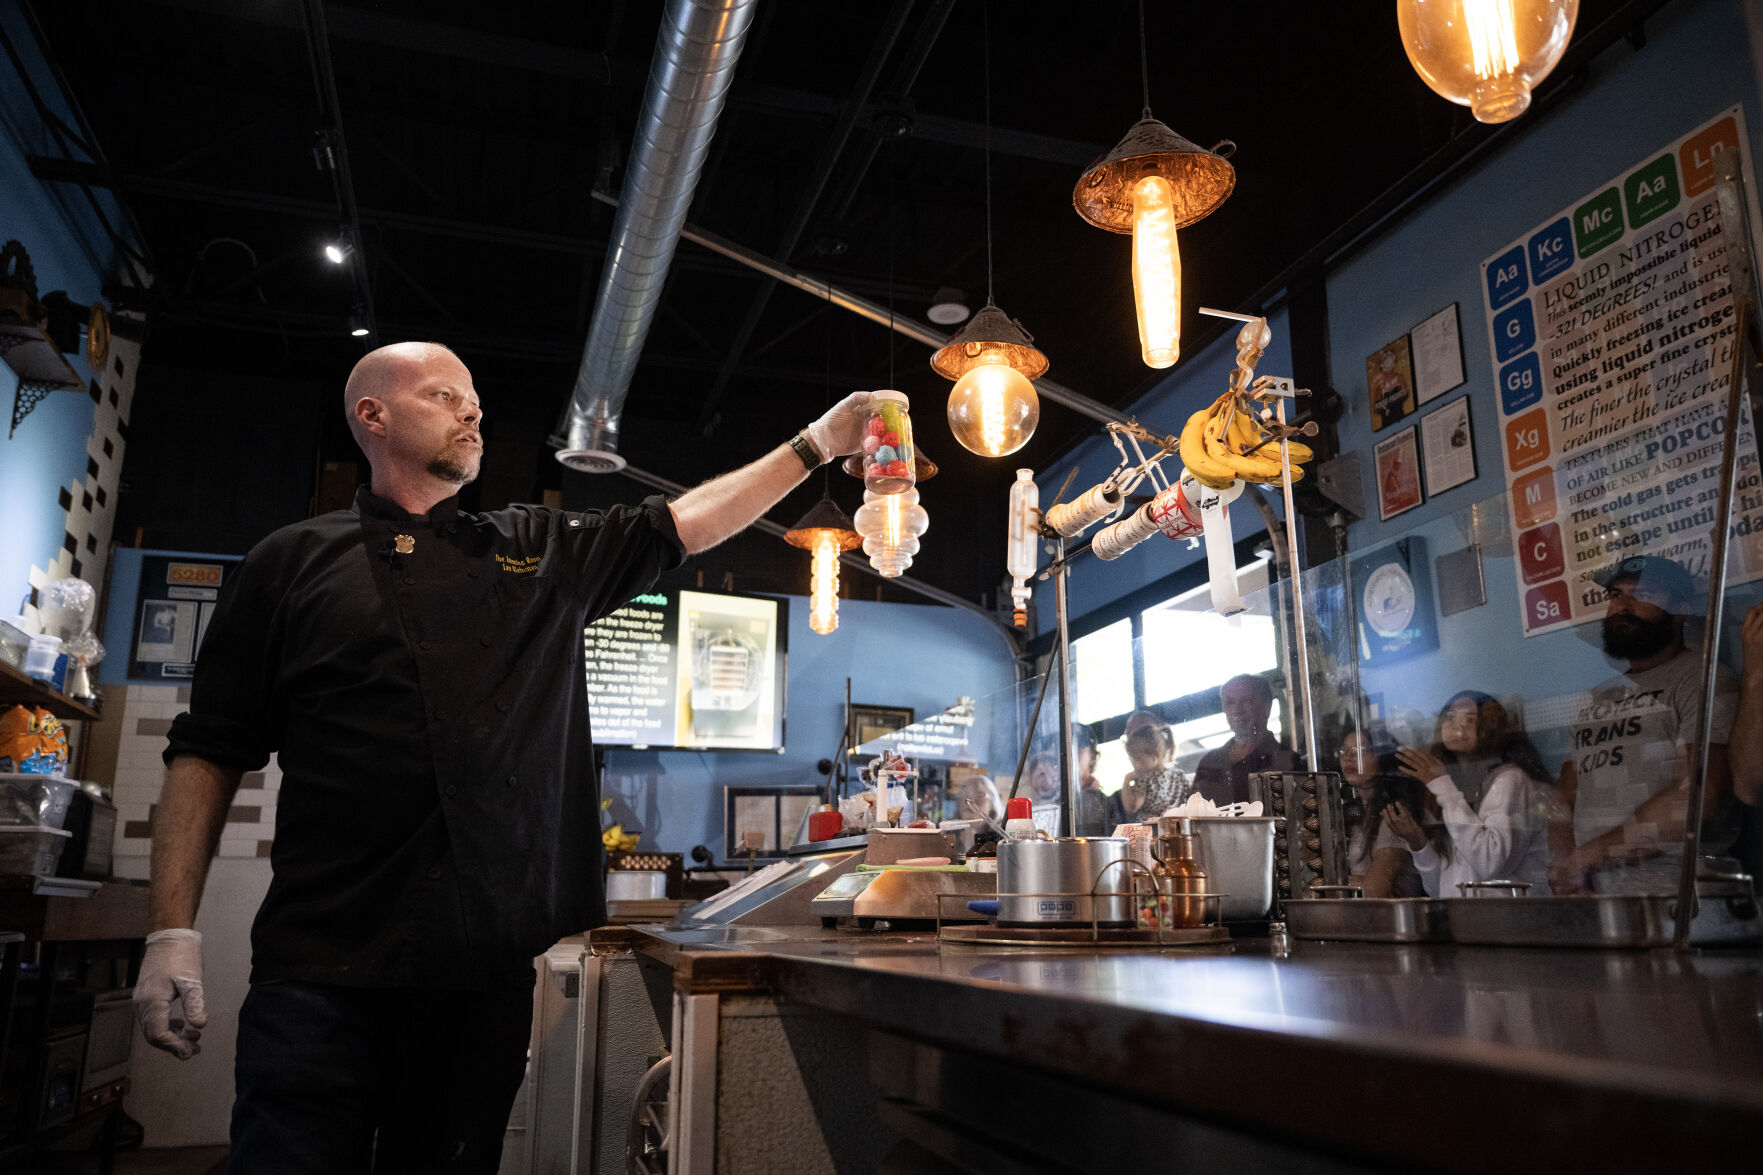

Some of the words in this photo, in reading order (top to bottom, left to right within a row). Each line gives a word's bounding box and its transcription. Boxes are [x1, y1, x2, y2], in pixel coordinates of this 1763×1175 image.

[1636, 175, 1667, 204] Aa
[1582, 206, 1614, 235] Mc
[1537, 236, 1563, 262] Kc
[1495, 264, 1519, 288] Aa
[1544, 262, 1610, 309] LIQUID
[1547, 308, 1567, 324] This
[1568, 285, 1607, 313] seemly
[1610, 247, 1677, 290] impossible
[1680, 223, 1721, 253] liquid
[1549, 316, 1577, 340] -321
[1580, 274, 1657, 327] DEGREES!
[1663, 260, 1688, 284] and
[1692, 256, 1703, 269] is
[1507, 318, 1521, 339] G
[1550, 347, 1562, 360] in
[1566, 329, 1599, 352] many
[1603, 299, 1659, 333] different
[1553, 346, 1603, 378] Quickly
[1606, 317, 1664, 352] freezing
[1668, 305, 1689, 323] ice
[1554, 367, 1598, 395] using
[1601, 339, 1654, 374] liquid
[1658, 305, 1734, 348] nitroge
[1507, 368, 1533, 392] Gg
[1557, 387, 1602, 410] creates
[1605, 379, 1613, 389] a
[1617, 359, 1656, 383] super
[1661, 344, 1690, 365] fine
[1561, 411, 1586, 433] The
[1589, 395, 1624, 427] finer
[1627, 380, 1652, 403] the
[1656, 347, 1717, 393] crystal
[1563, 416, 1629, 453] creamier
[1632, 400, 1660, 424] the
[1664, 391, 1686, 410] ice
[1691, 373, 1730, 404] crea
[1564, 436, 1629, 470] TEXTURES
[1632, 419, 1672, 446] THAT
[1674, 403, 1714, 428] HAVE
[1514, 428, 1539, 450] Xg
[1526, 484, 1541, 504] M
[1567, 475, 1586, 490] OF
[1587, 465, 1609, 484] AIR
[1612, 452, 1643, 474] LIKE
[1569, 482, 1617, 506] BECOME
[1621, 470, 1651, 487] NEW
[1654, 456, 1683, 477] AND
[1571, 506, 1599, 524] The
[1602, 492, 1633, 513] cold
[1637, 485, 1662, 505] gas
[1665, 472, 1698, 495] gets
[1574, 530, 1589, 544] in
[1592, 521, 1616, 539] the
[1619, 495, 1694, 529] structure
[1697, 486, 1720, 503] an
[1534, 542, 1547, 562] C
[1576, 545, 1601, 562] not
[1605, 525, 1663, 553] escape
[1667, 505, 1715, 534] until
[1656, 537, 1708, 560] warm,
[174, 568, 218, 582] 5280
[1536, 600, 1560, 620] Sa
